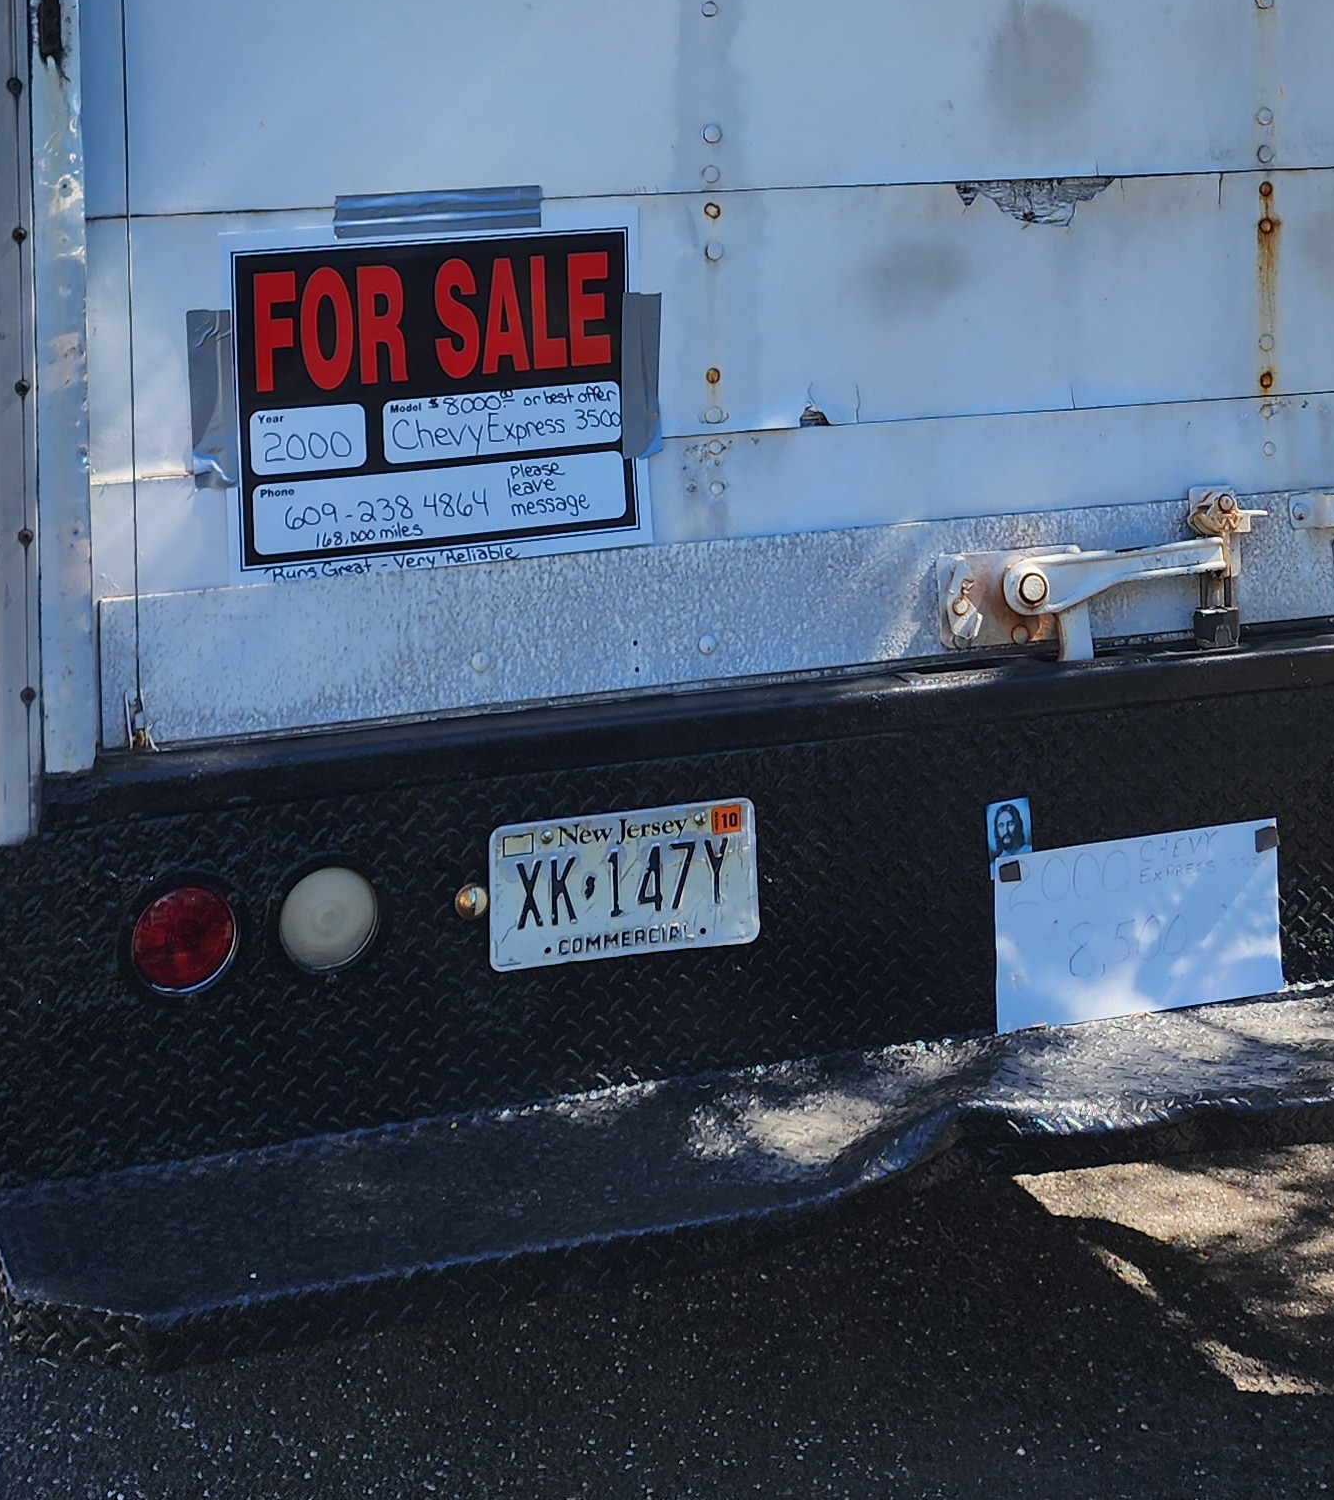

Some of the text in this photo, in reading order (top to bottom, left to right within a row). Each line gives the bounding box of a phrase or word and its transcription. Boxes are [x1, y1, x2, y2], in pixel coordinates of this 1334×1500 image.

[253, 251, 612, 393] FOR SALE
[390, 404, 422, 414] Model
[523, 395, 541, 407] or
[544, 388, 574, 405] best
[578, 386, 618, 404] offer
[258, 415, 284, 424] Year
[392, 408, 621, 455] Chevy Express 3500
[263, 431, 352, 462] 2000
[260, 488, 295, 499] Phone
[507, 477, 556, 498] leave
[423, 488, 490, 518] 4864
[511, 493, 591, 517] message
[315, 522, 423, 548] 168,000 miles
[264, 566, 317, 582] Runs
[321, 560, 372, 578] Great
[395, 553, 436, 569] Very
[441, 546, 520, 565] Reliable
[558, 818, 688, 848] New Jersey
[722, 812, 738, 828] 10
[1139, 831, 1218, 863] CHEVY
[1009, 850, 1130, 911] 2000
[558, 922, 696, 955] COMMERCIAL
